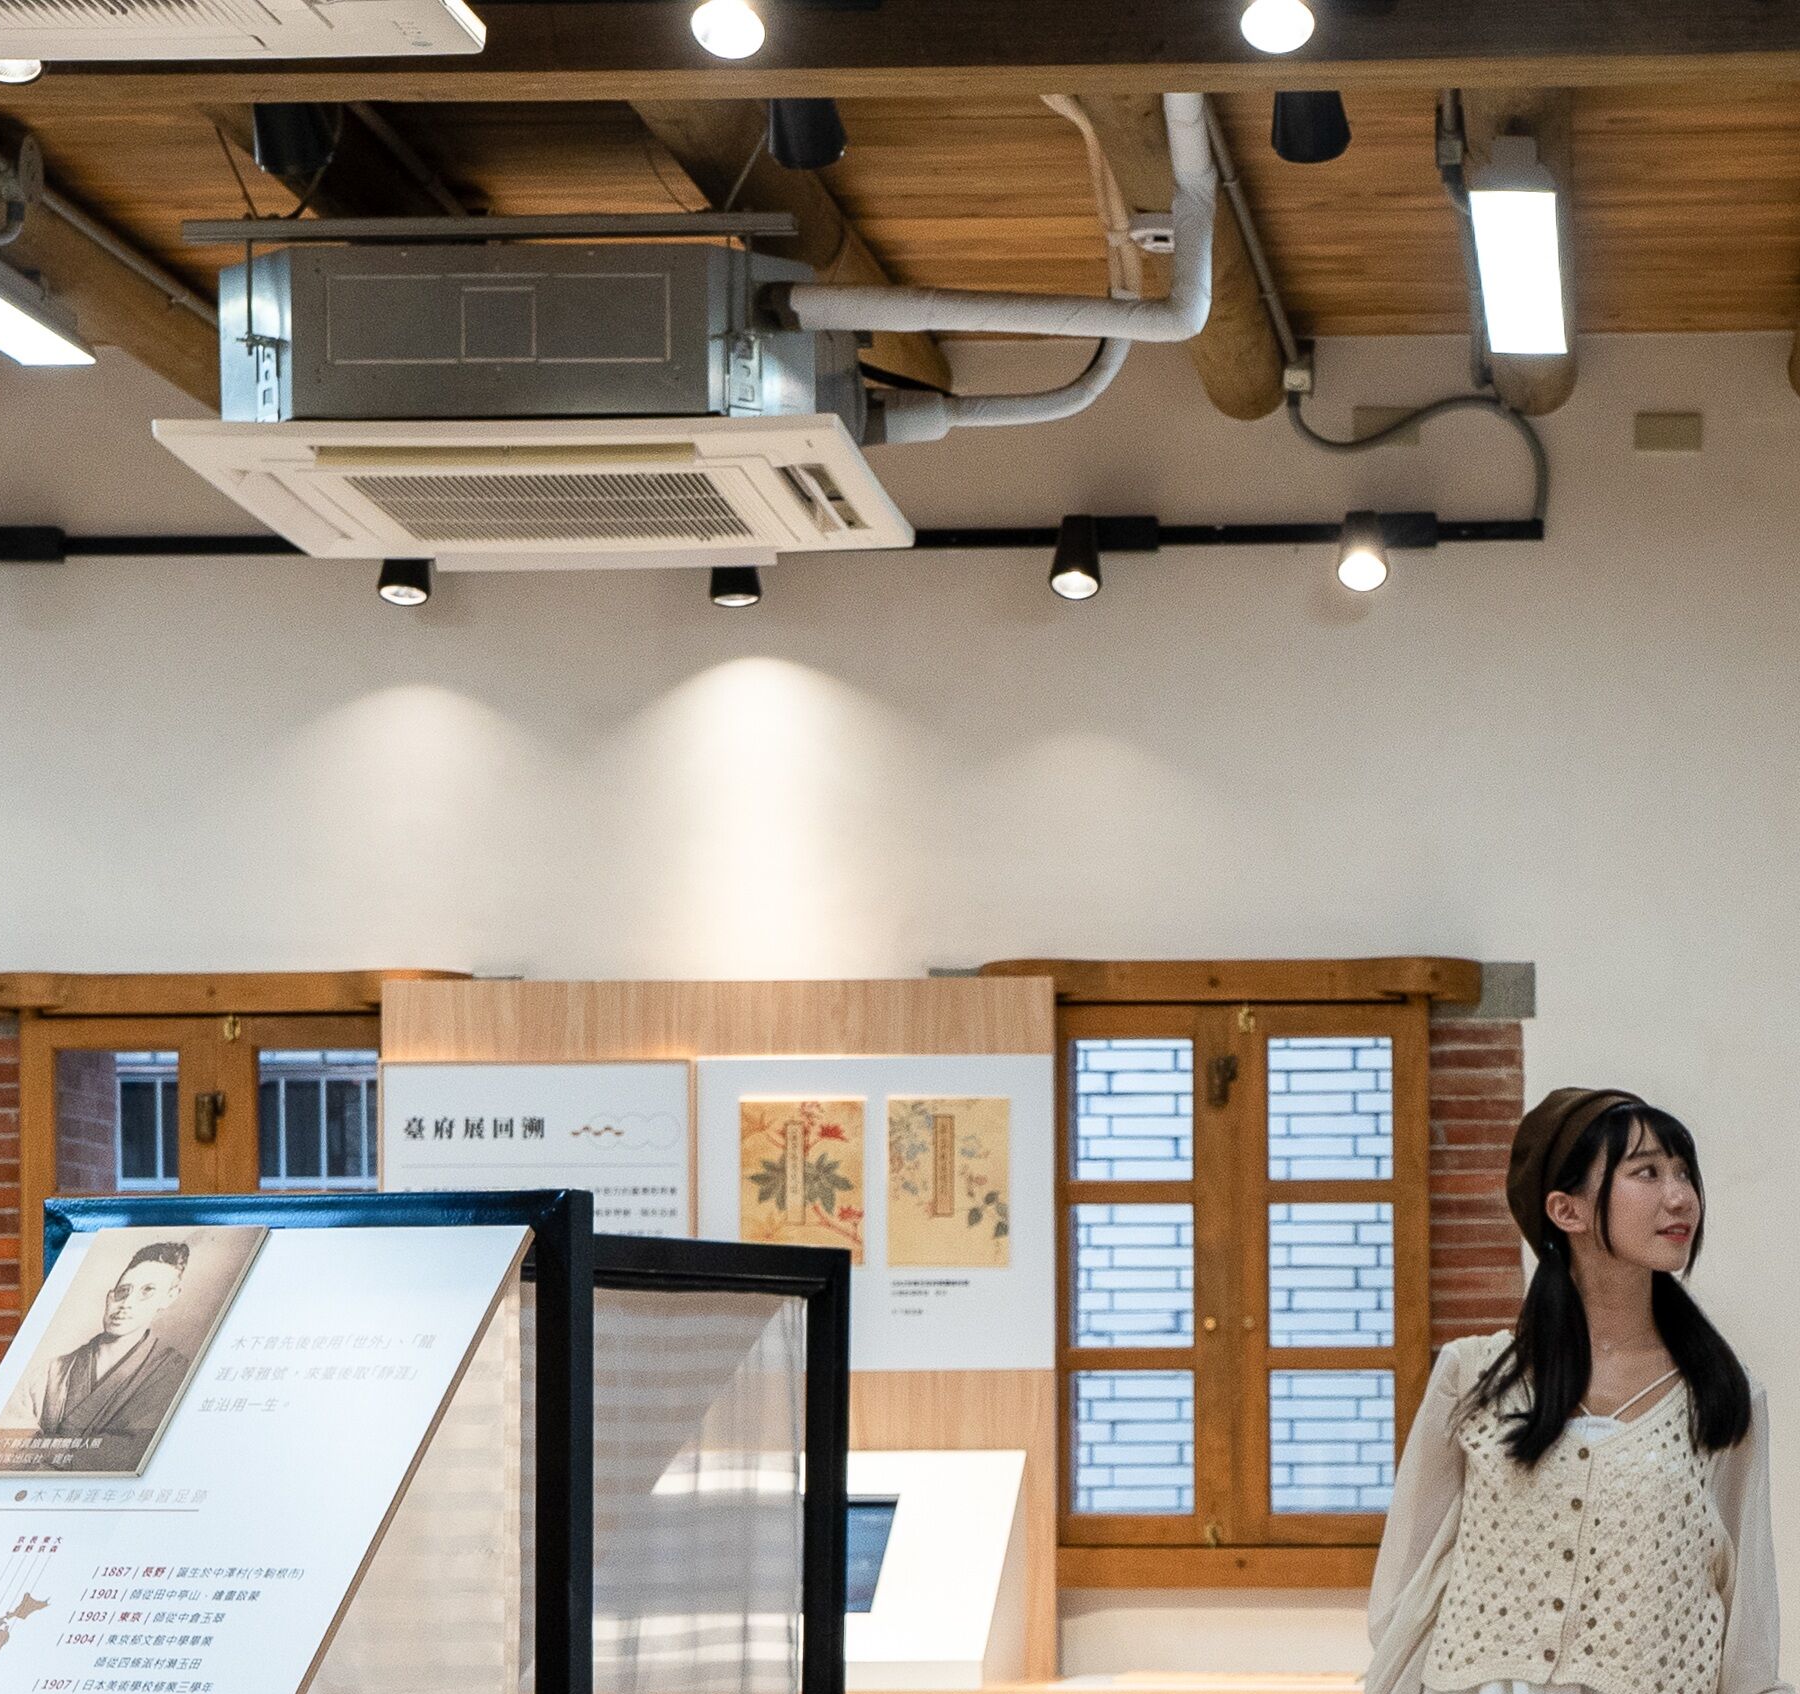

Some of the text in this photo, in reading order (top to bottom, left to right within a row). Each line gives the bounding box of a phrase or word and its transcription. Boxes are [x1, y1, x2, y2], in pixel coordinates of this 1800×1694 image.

[403, 1114, 546, 1141] 臺府展回溯
[197, 1396, 291, 1413] 並沿用一生。
[100, 1566, 132, 1577] 1887
[142, 1566, 167, 1578] 長野
[89, 1588, 119, 1600] 1901
[77, 1611, 107, 1622] 1903
[117, 1611, 143, 1623] 東京
[64, 1633, 96, 1645] 1904
[40, 1679, 72, 1691] 1907
